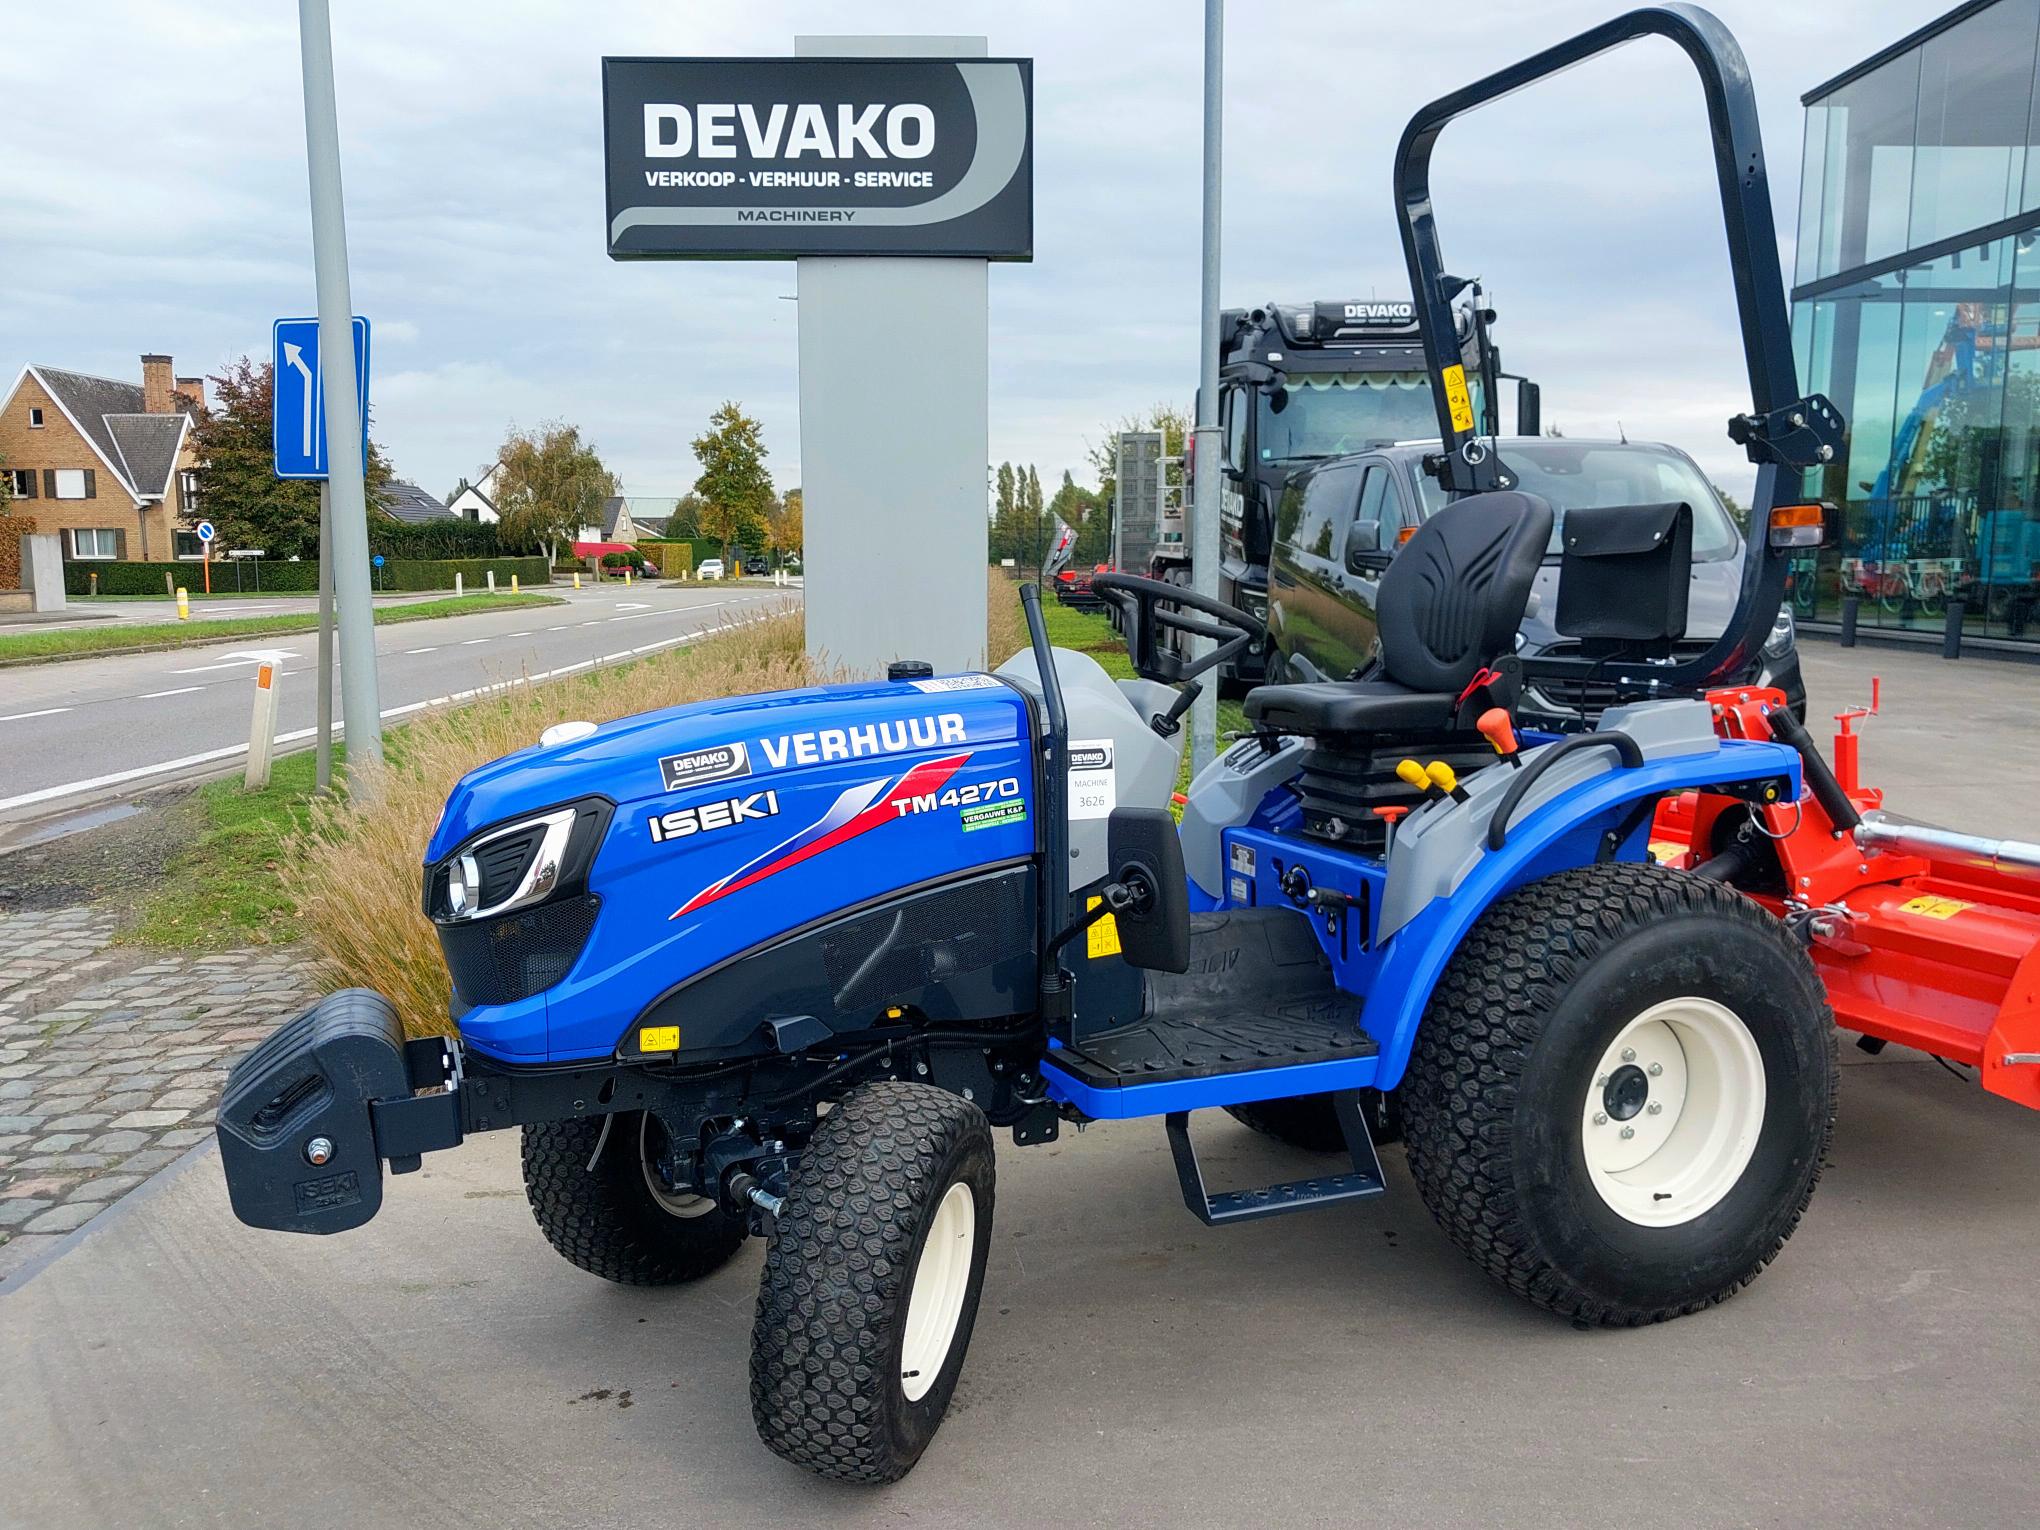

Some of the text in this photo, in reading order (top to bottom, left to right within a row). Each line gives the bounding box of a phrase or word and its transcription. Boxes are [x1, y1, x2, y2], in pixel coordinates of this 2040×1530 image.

[643, 103, 936, 159] DEVAKO
[645, 171, 735, 187] VERKOOP
[749, 171, 840, 187] VERHUUR
[854, 171, 933, 187] SERVICE
[737, 210, 857, 222] MACHINERY
[1344, 304, 1412, 318] DEVAKO
[760, 713, 967, 769] VERHUUR
[673, 751, 729, 771] DEVAKO
[1071, 752, 1104, 762] DEVAKO
[1074, 778, 1108, 788] MACHINE
[1079, 795, 1105, 808] 3626
[648, 790, 779, 843] ISEKI
[963, 810, 1006, 823] VERGAUWE
[1007, 805, 1024, 815] K&P
